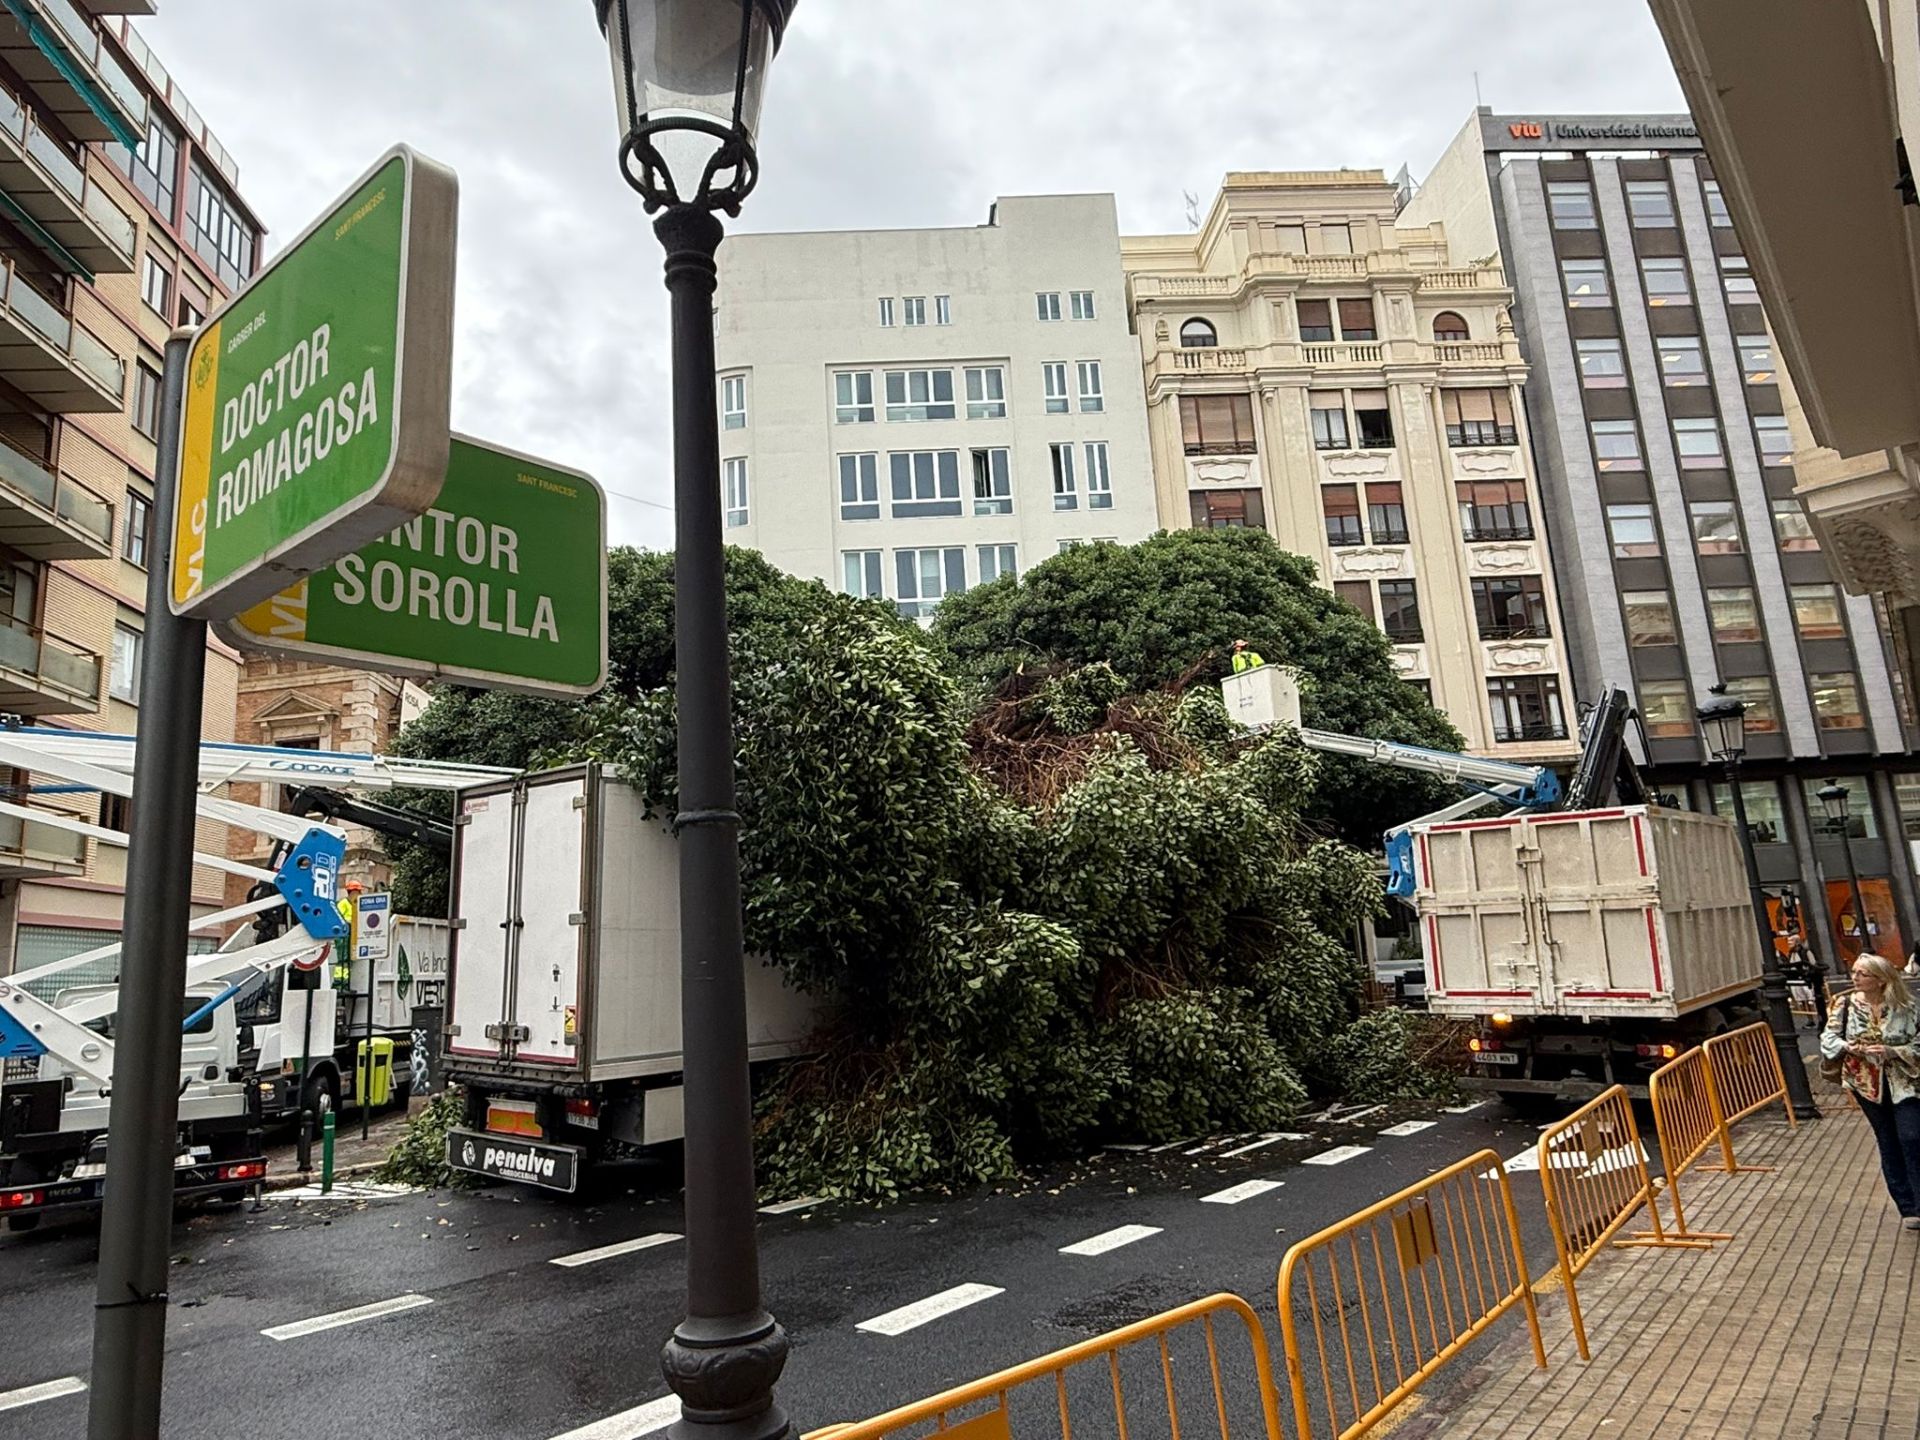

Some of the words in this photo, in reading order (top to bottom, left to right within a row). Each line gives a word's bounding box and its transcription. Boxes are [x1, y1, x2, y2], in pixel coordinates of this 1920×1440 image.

[1509, 121, 1543, 139] viu
[1555, 124, 1641, 139] Universidad
[227, 321, 253, 353] CARRER
[253, 310, 266, 331] DEL
[221, 323, 331, 454] DOCTOR
[216, 367, 378, 529] ROMAGOSA
[517, 473, 538, 487] SANT
[538, 479, 577, 498] FRANCESC
[186, 498, 208, 600] VLC
[375, 507, 519, 574] NTOR
[333, 553, 560, 643] SOROLLA
[483, 1147, 555, 1177] penalva
